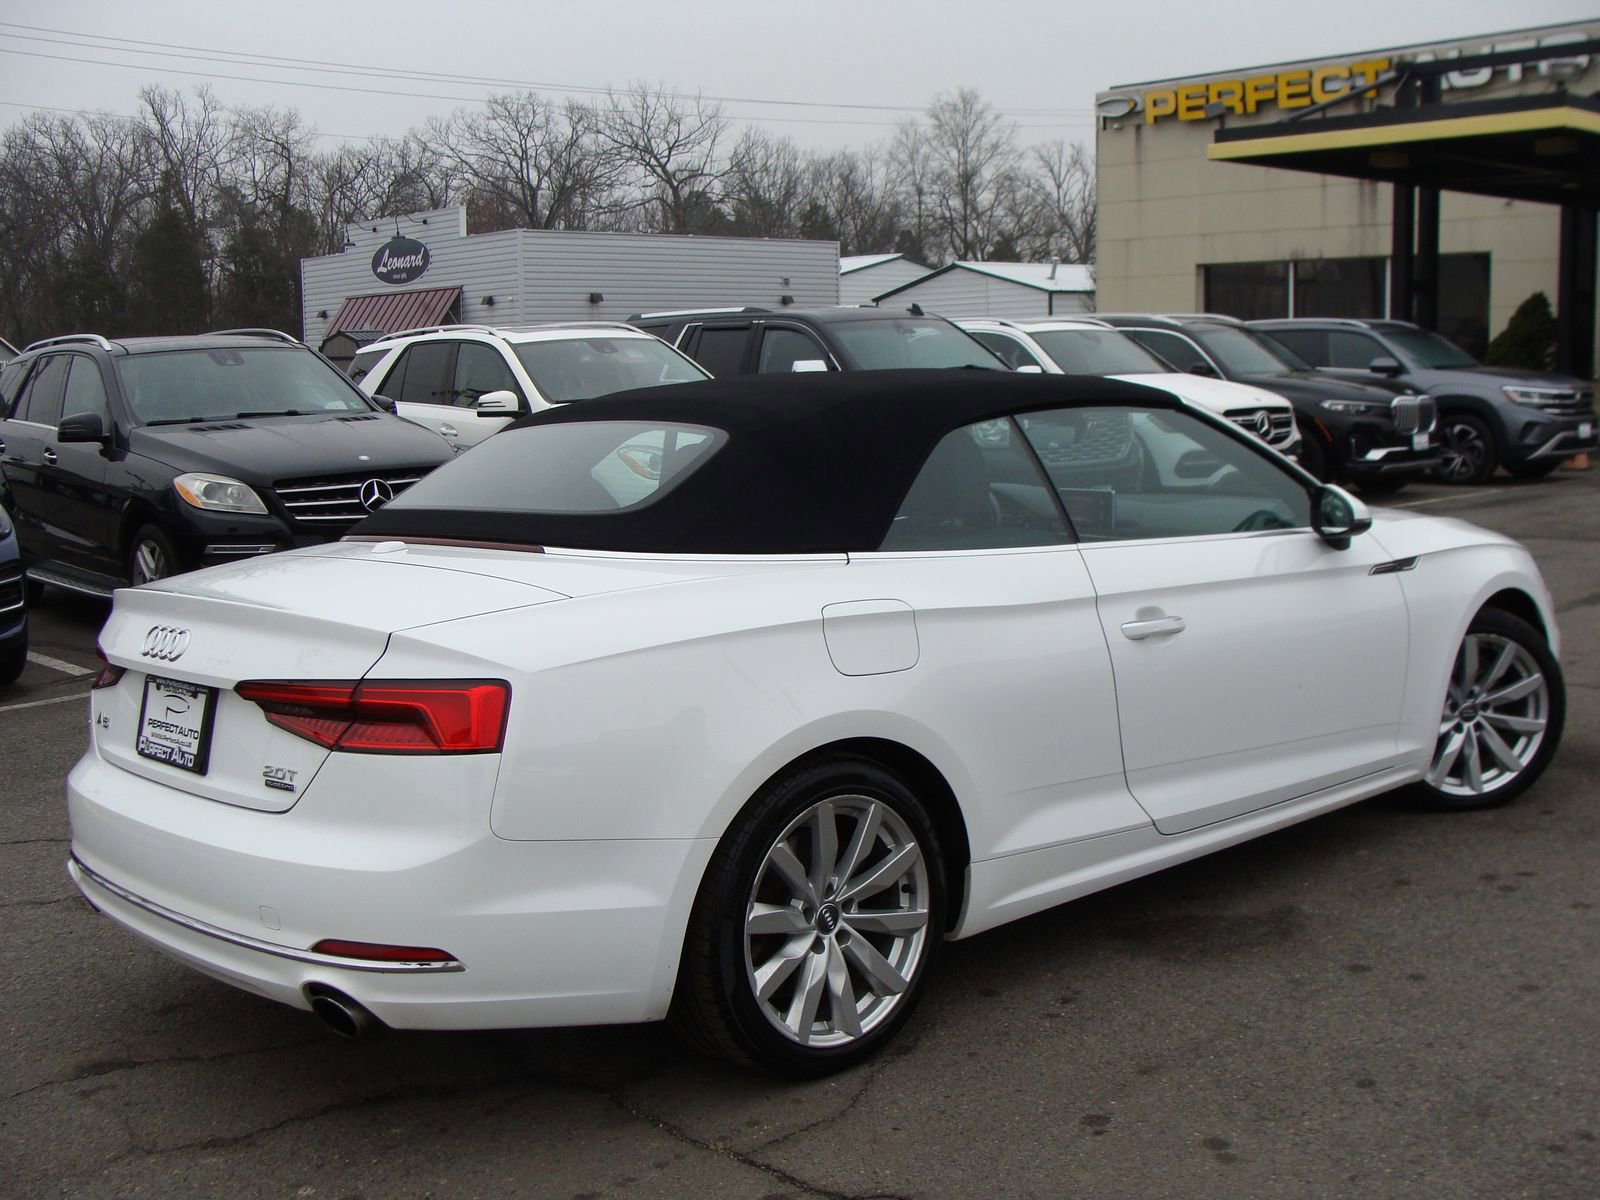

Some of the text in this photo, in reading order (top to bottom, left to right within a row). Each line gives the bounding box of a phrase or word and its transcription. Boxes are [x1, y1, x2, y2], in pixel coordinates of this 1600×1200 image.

[1144, 32, 1590, 124] PERFECT UTO
[377, 246, 425, 273] Leonard
